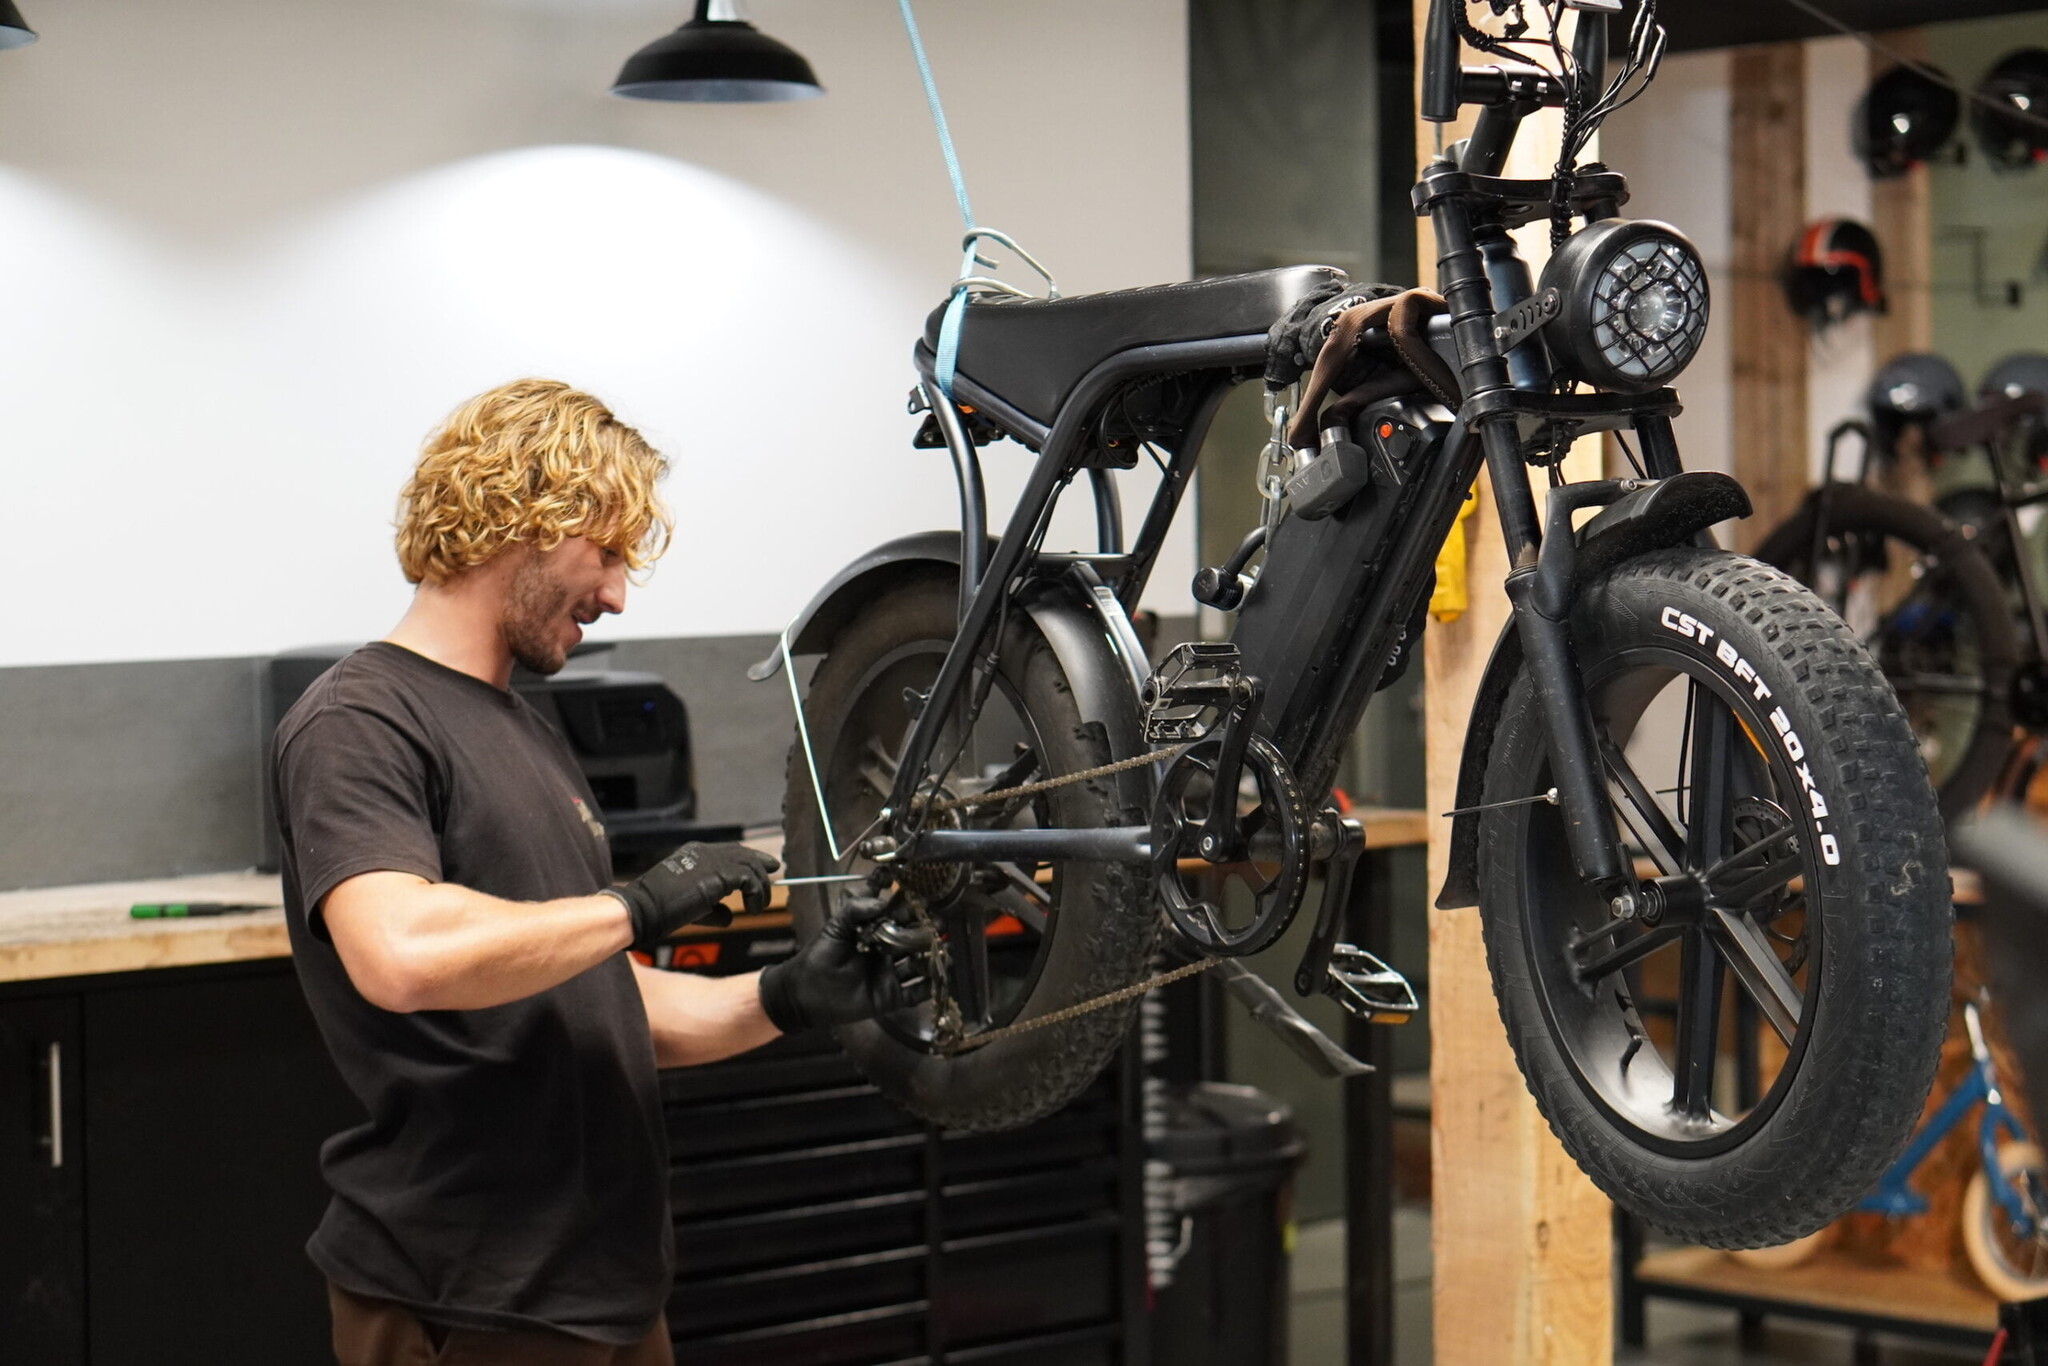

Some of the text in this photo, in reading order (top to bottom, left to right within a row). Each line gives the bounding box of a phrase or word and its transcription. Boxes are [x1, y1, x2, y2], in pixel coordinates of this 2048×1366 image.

[1661, 606, 1840, 866] CST BFT 20X4.0
